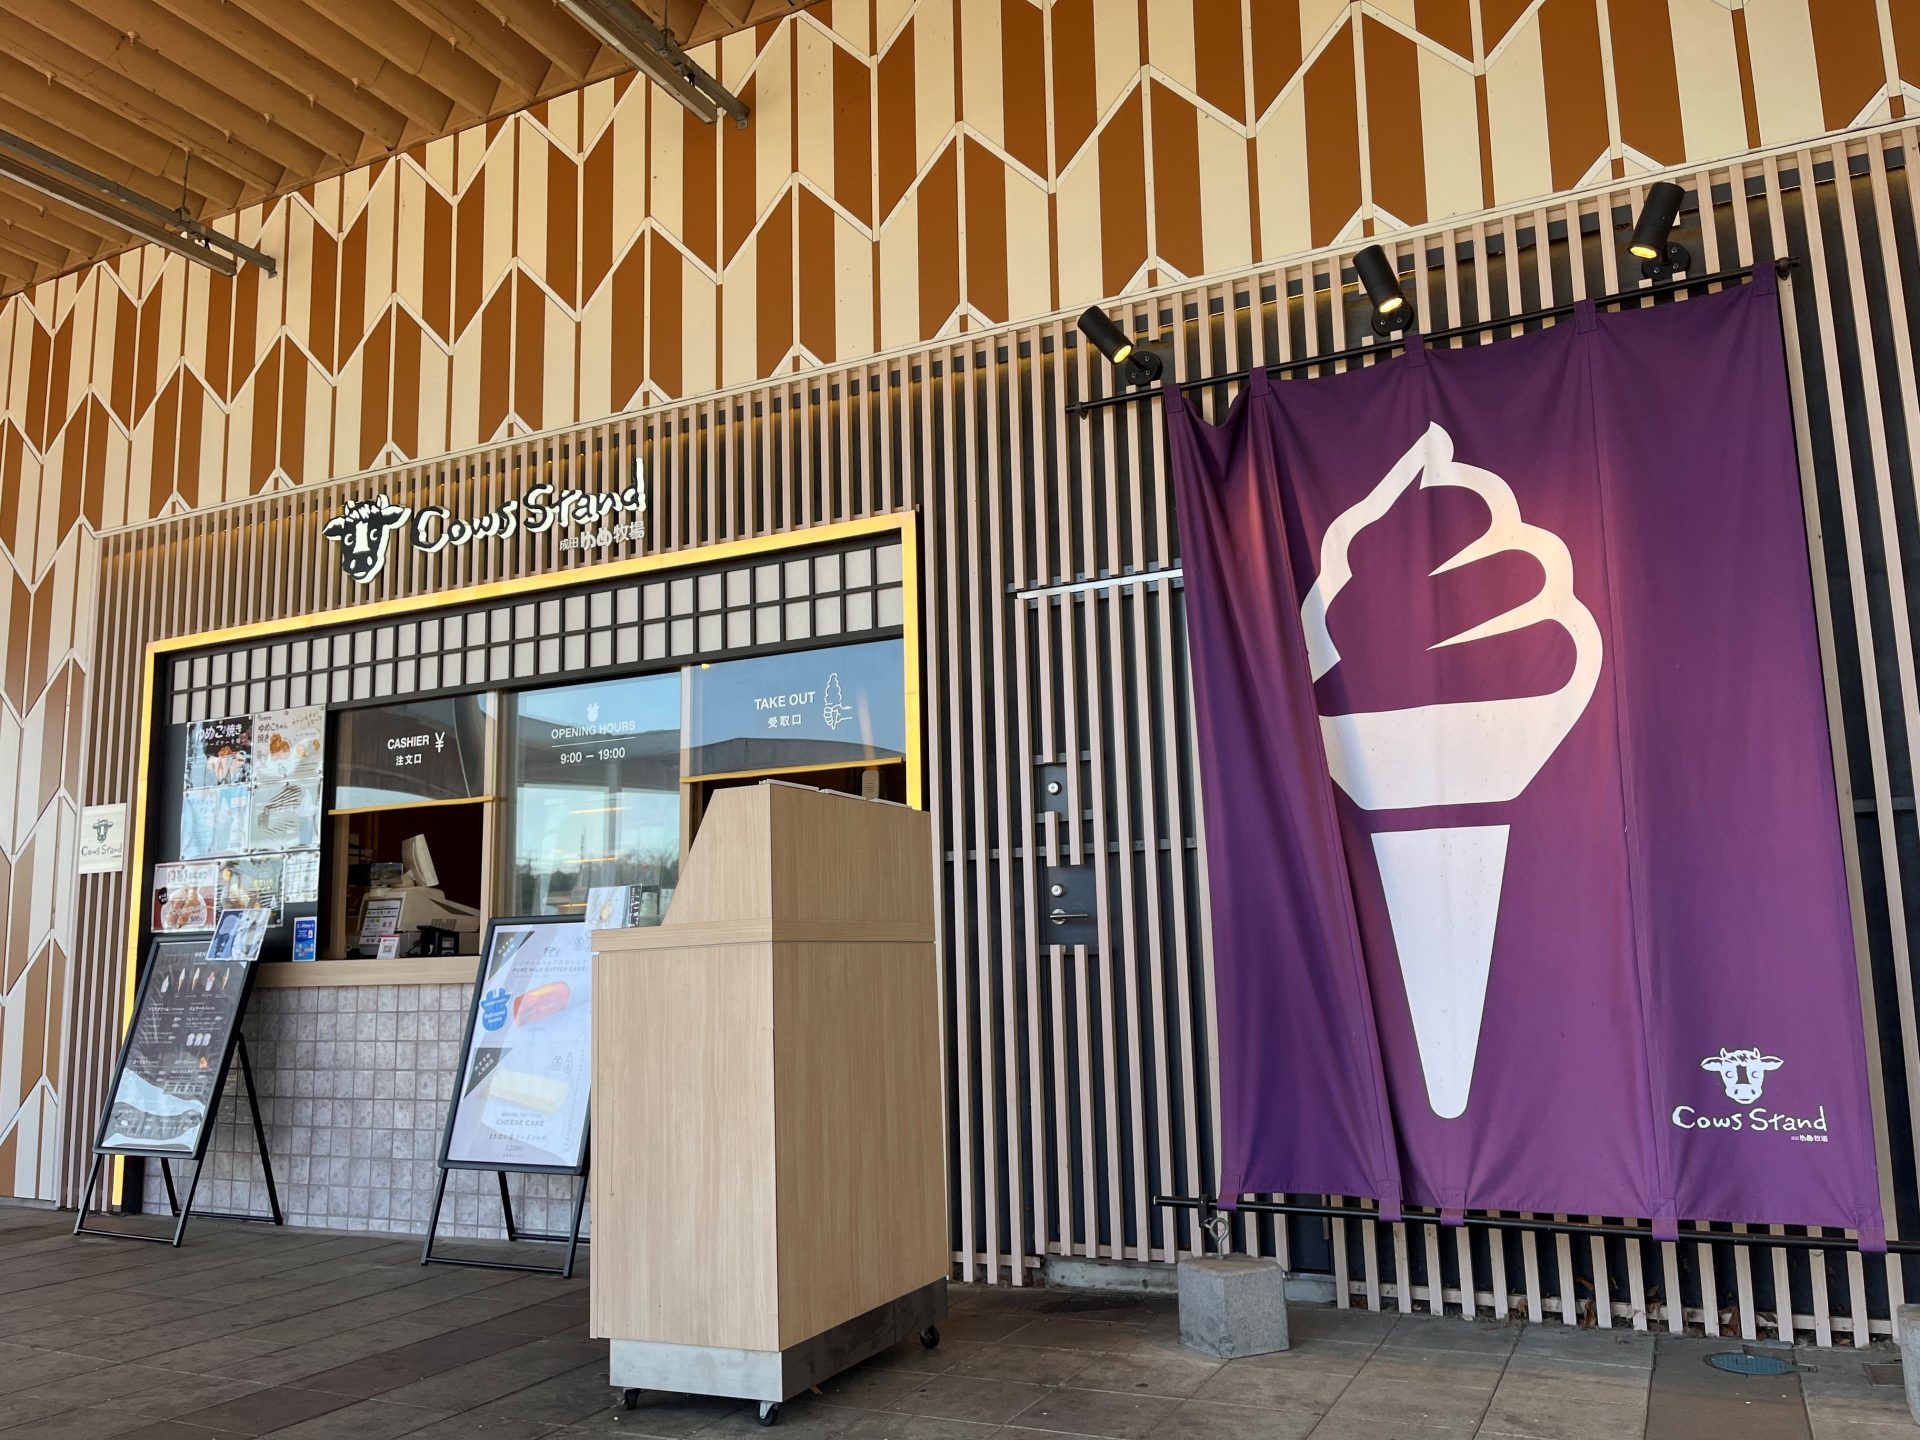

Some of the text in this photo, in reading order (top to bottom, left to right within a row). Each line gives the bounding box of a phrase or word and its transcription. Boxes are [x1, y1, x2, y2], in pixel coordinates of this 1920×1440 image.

[412, 457, 647, 553] Cows Stand
[753, 691, 816, 711] TAKE OUT
[551, 720, 636, 739] OPENING HOURS
[767, 714, 801, 729] 受取口
[387, 734, 430, 750] CASHIER
[395, 753, 422, 766] 注文口
[560, 751, 583, 765] 9:00
[598, 747, 626, 760] 19:00
[81, 842, 122, 856] Cows Stand
[1672, 1105, 1828, 1132] Cows Stand
